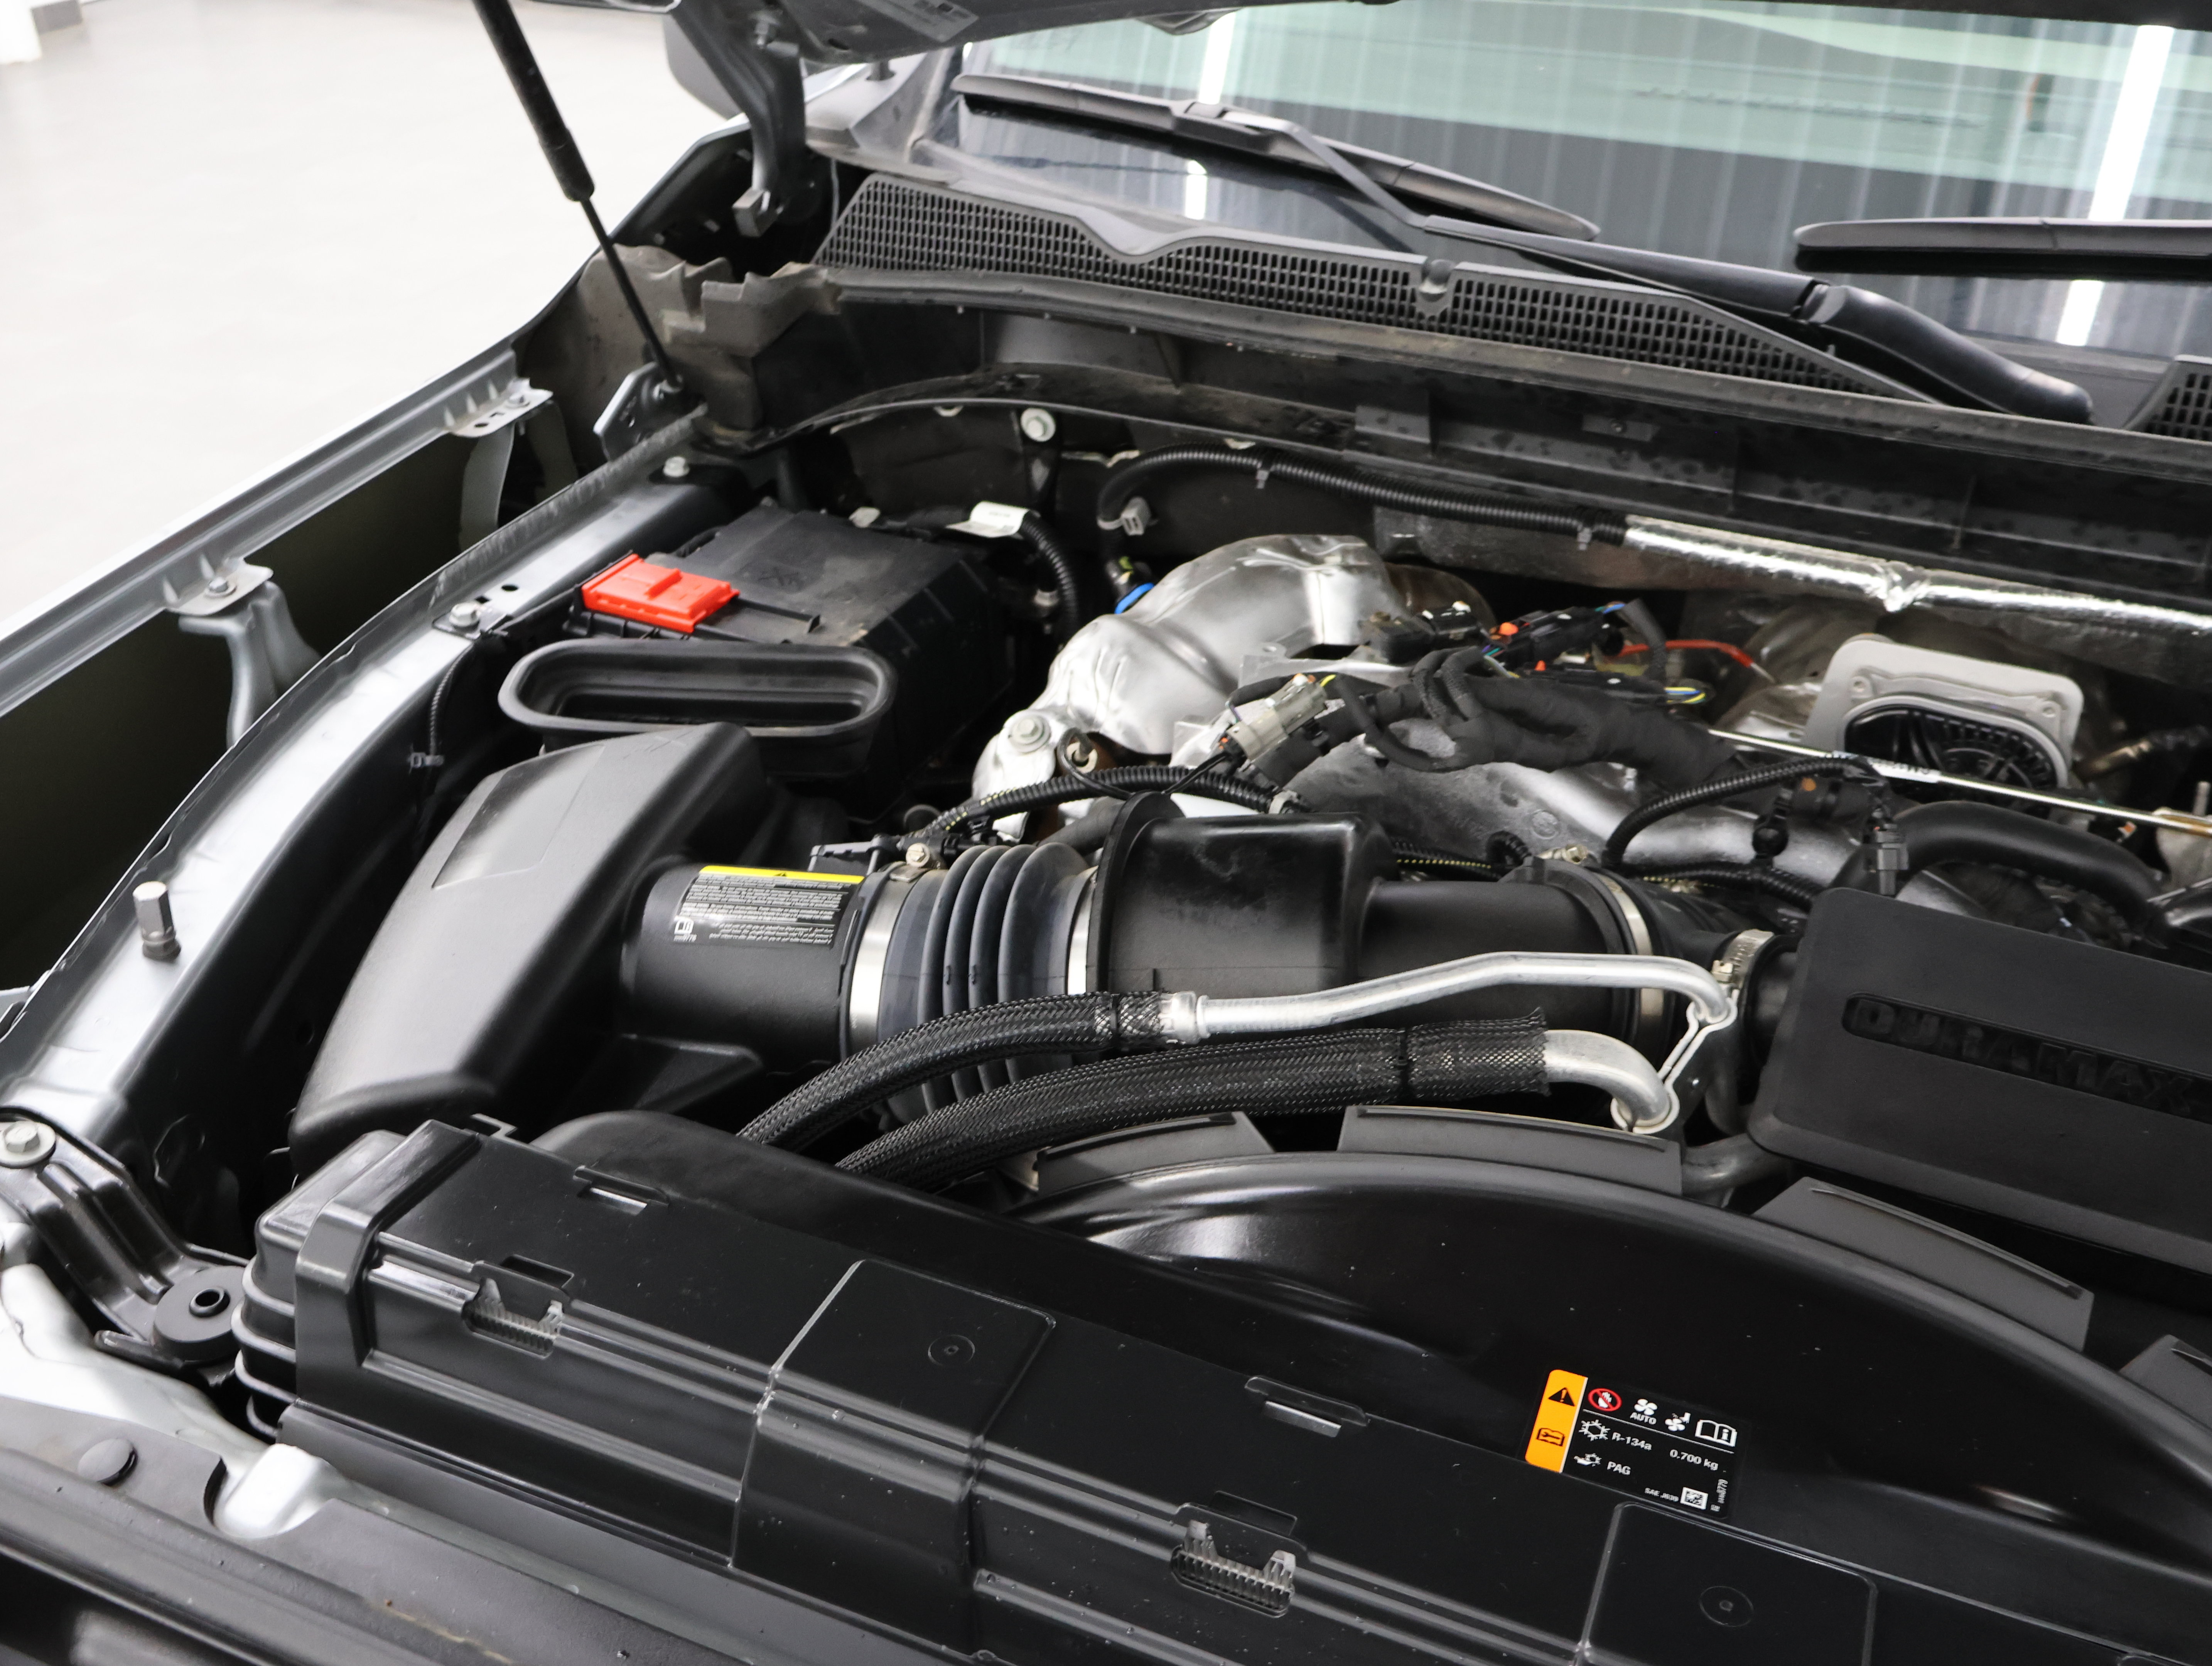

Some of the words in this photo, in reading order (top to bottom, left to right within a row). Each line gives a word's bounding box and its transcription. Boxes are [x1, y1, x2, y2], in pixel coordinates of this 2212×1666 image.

[1851, 1000, 2193, 1115] DURAMAX
[1630, 1412, 1657, 1425] AUTO
[1611, 1432, 1652, 1451] R-134a
[1607, 1461, 1631, 1475] PAG
[1670, 1449, 1702, 1465] 0.700
[1704, 1458, 1718, 1471] kg
[1645, 1487, 1660, 1497] SAE
